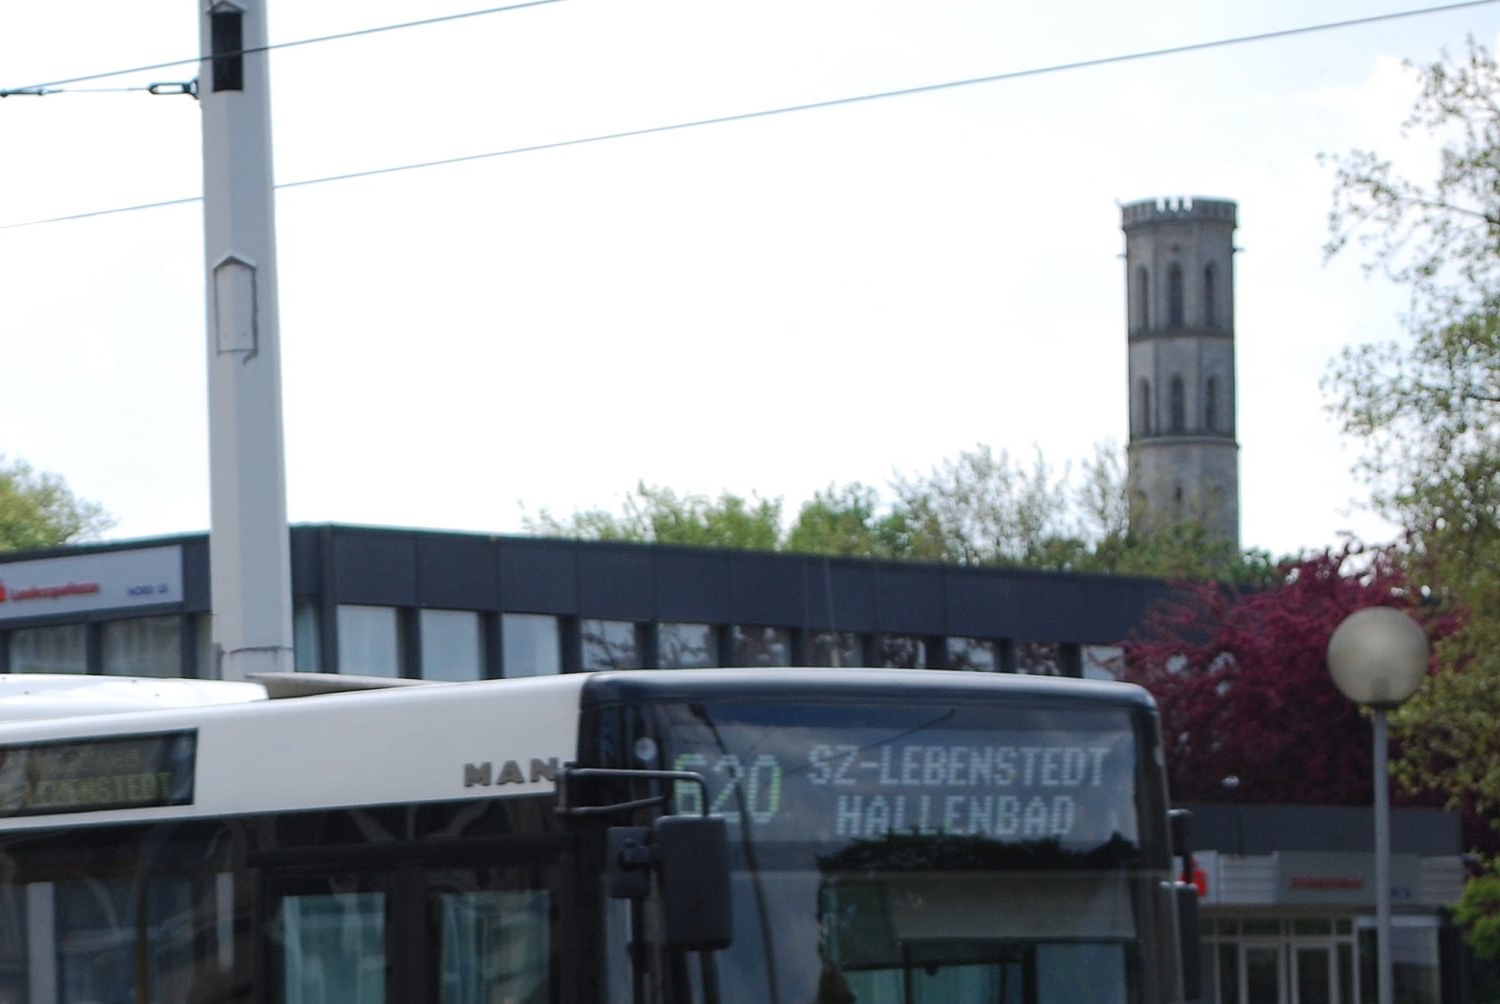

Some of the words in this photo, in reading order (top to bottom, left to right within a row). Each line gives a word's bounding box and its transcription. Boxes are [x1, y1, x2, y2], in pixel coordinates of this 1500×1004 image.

[463, 757, 559, 788] MAN
[807, 745, 1111, 787] SZ-LEBENSTEDT
[674, 753, 781, 824] 620
[836, 795, 1076, 834] HALLENBAD
